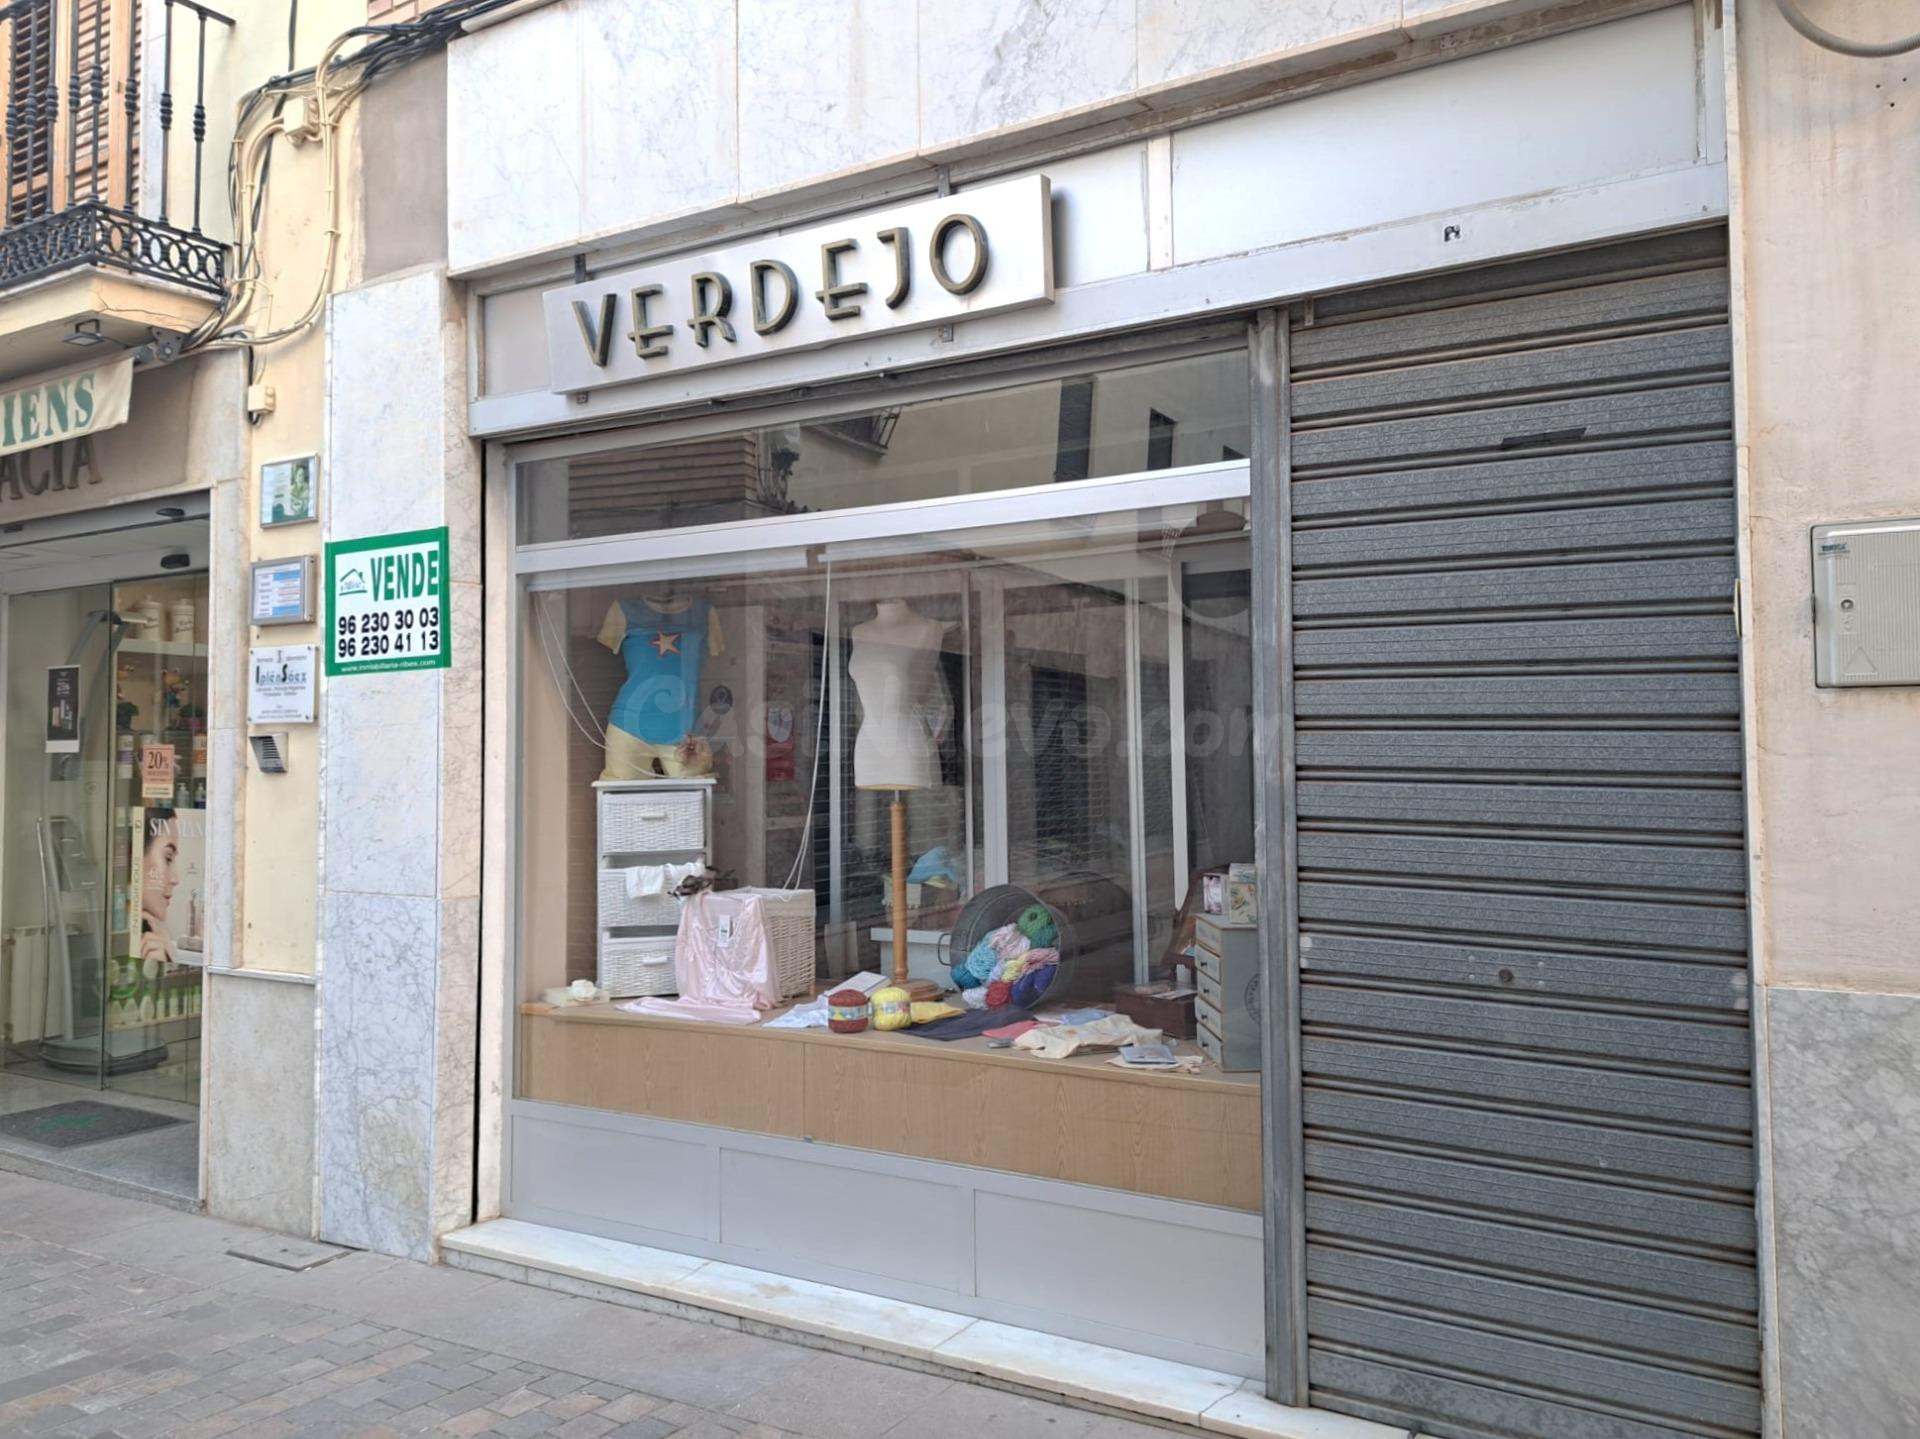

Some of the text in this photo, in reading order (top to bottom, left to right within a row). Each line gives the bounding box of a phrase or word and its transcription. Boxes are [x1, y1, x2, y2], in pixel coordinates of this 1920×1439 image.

[571, 213, 990, 368] VERDEJO
[370, 550, 439, 602] VENDE
[338, 606, 439, 635] 96 230 30 03
[338, 630, 439, 658] 96 230 41 13
